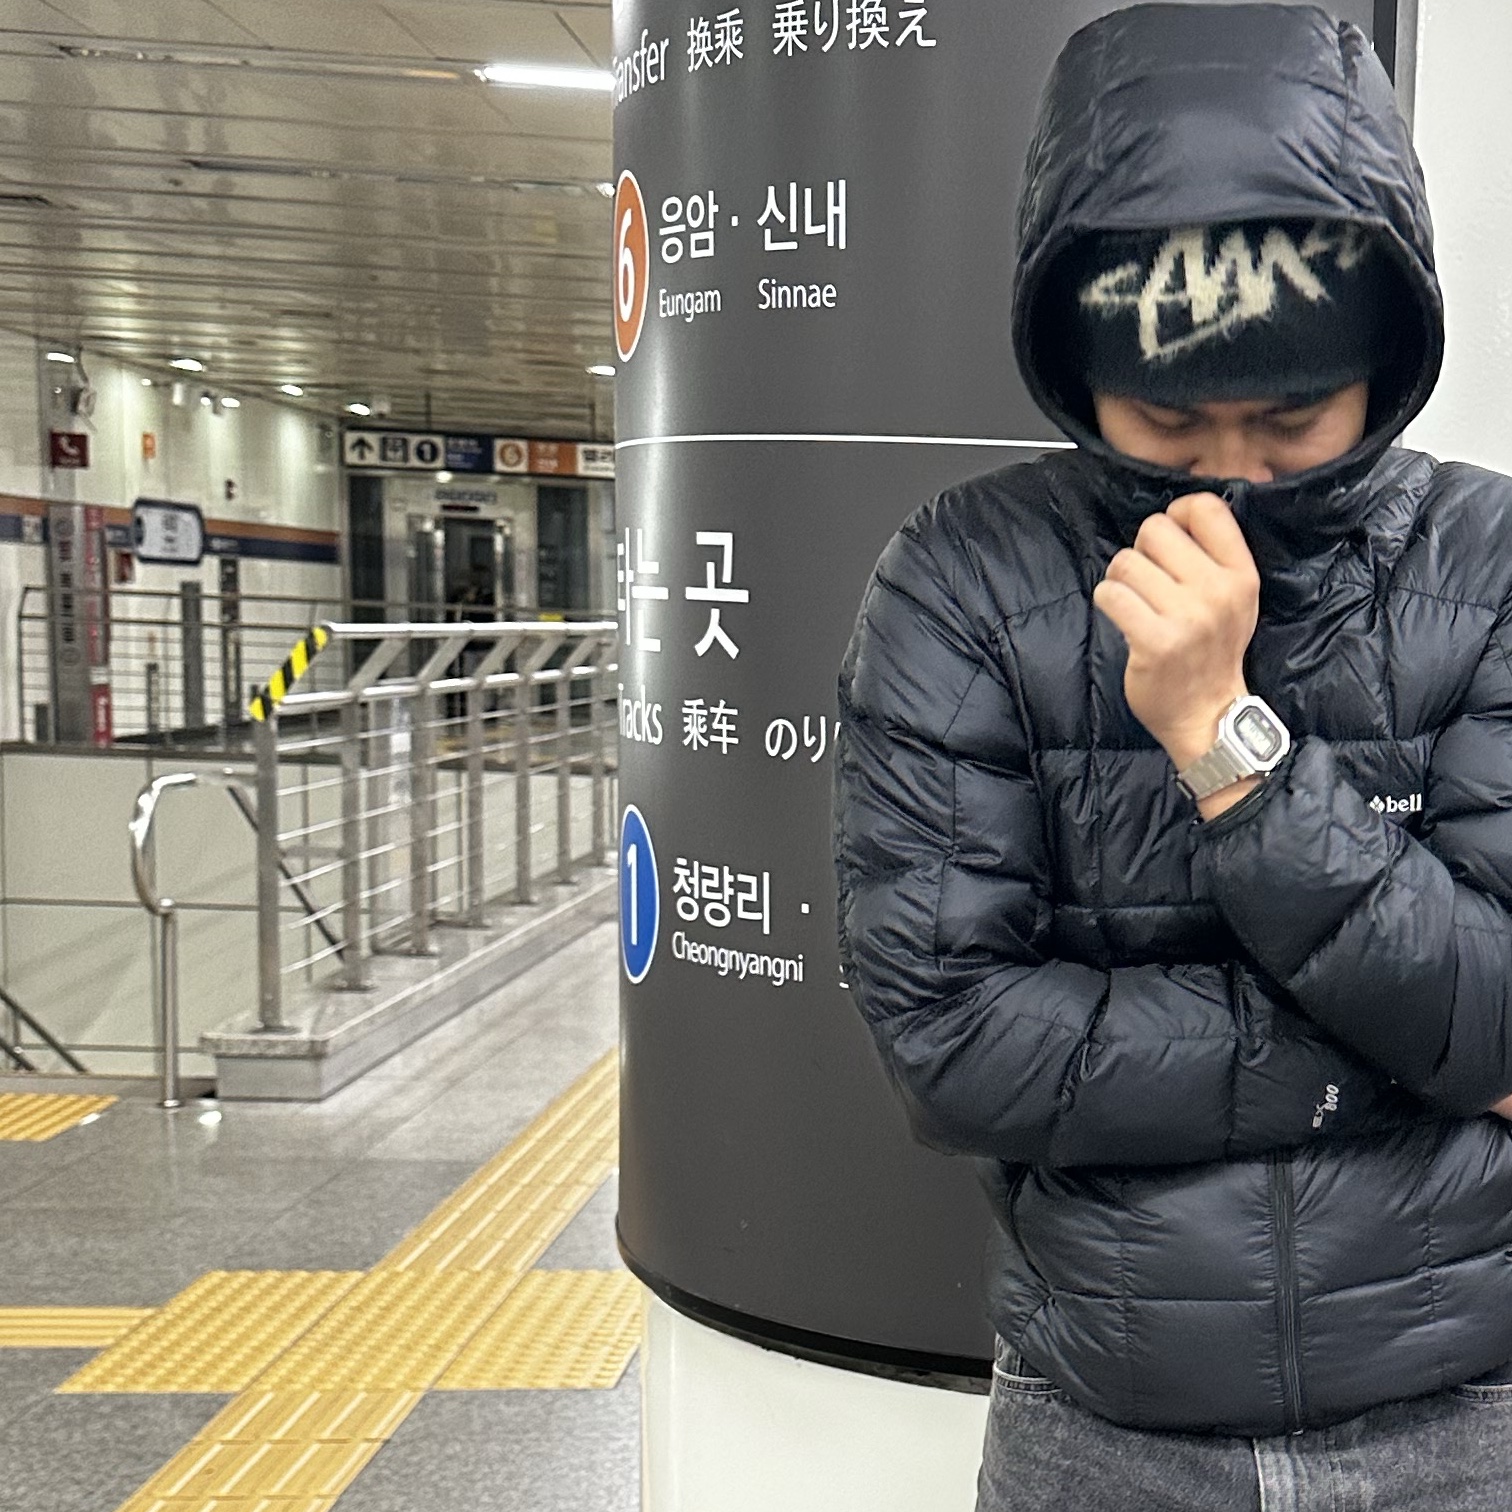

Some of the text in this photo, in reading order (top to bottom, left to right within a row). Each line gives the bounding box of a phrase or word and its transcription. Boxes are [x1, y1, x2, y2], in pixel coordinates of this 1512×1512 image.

[772, 0, 937, 57] 乗り換え
[659, 191, 719, 264] 응암
[757, 179, 847, 251] 신내
[618, 208, 635, 322] 6
[659, 278, 837, 323] Eungam Sinnae
[685, 531, 749, 660] 곳
[765, 715, 841, 763] のり
[1386, 793, 1422, 813] bell
[626, 843, 639, 947] 1
[672, 857, 770, 935] 청량리
[672, 931, 804, 987] Cheongnyangni
[1324, 1084, 1340, 1112] 800
